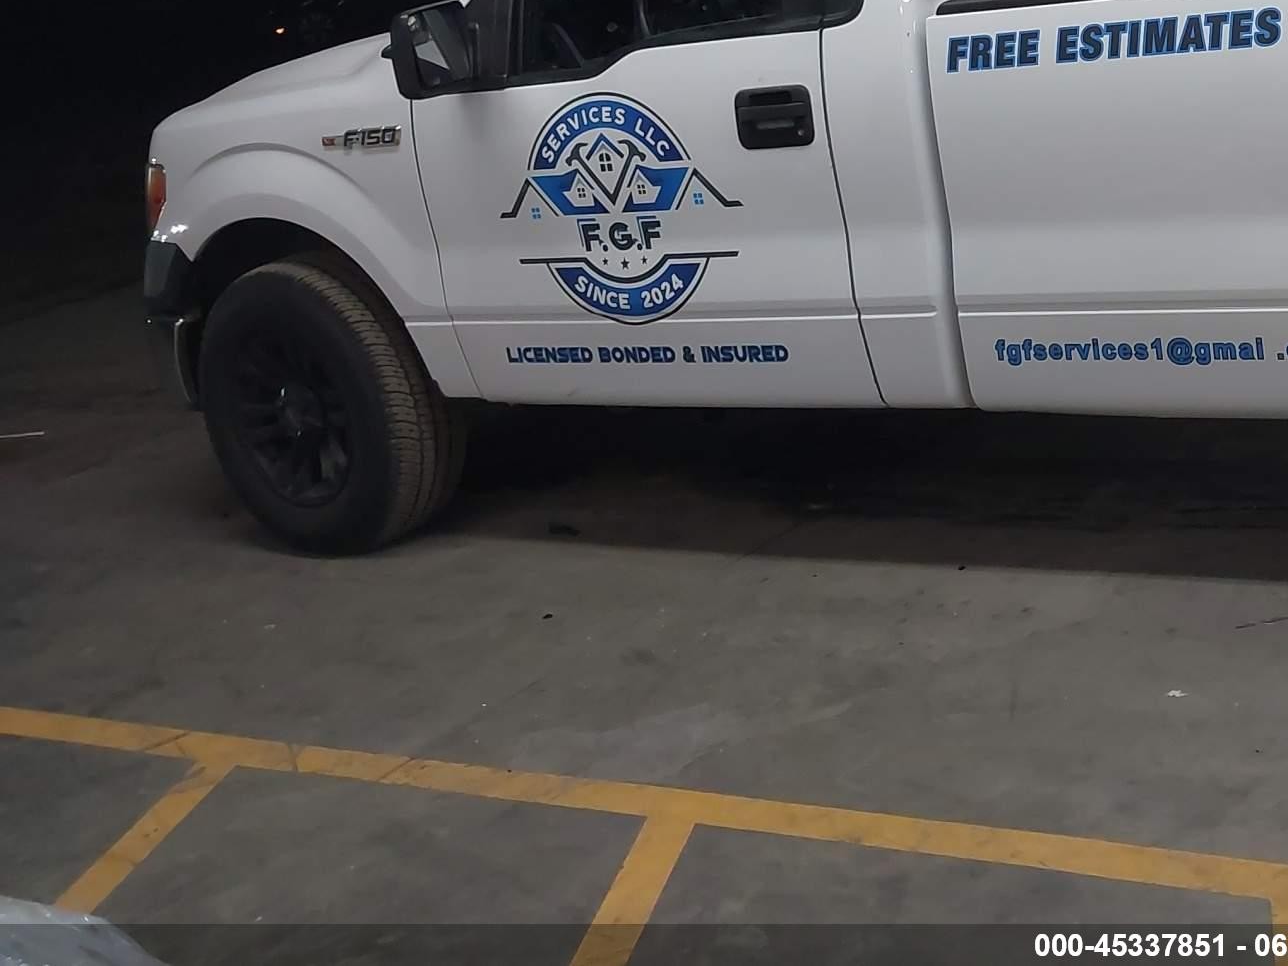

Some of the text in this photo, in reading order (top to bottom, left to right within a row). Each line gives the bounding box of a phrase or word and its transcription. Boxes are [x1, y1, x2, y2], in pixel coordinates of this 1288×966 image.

[946, 7, 1282, 74] FREE ESTIMATES
[541, 106, 670, 162] SERVICES LLC
[577, 216, 661, 252] F.G.F
[574, 274, 684, 310] SINCE 2024
[505, 345, 790, 364] LICENSED BONDED & INSURED
